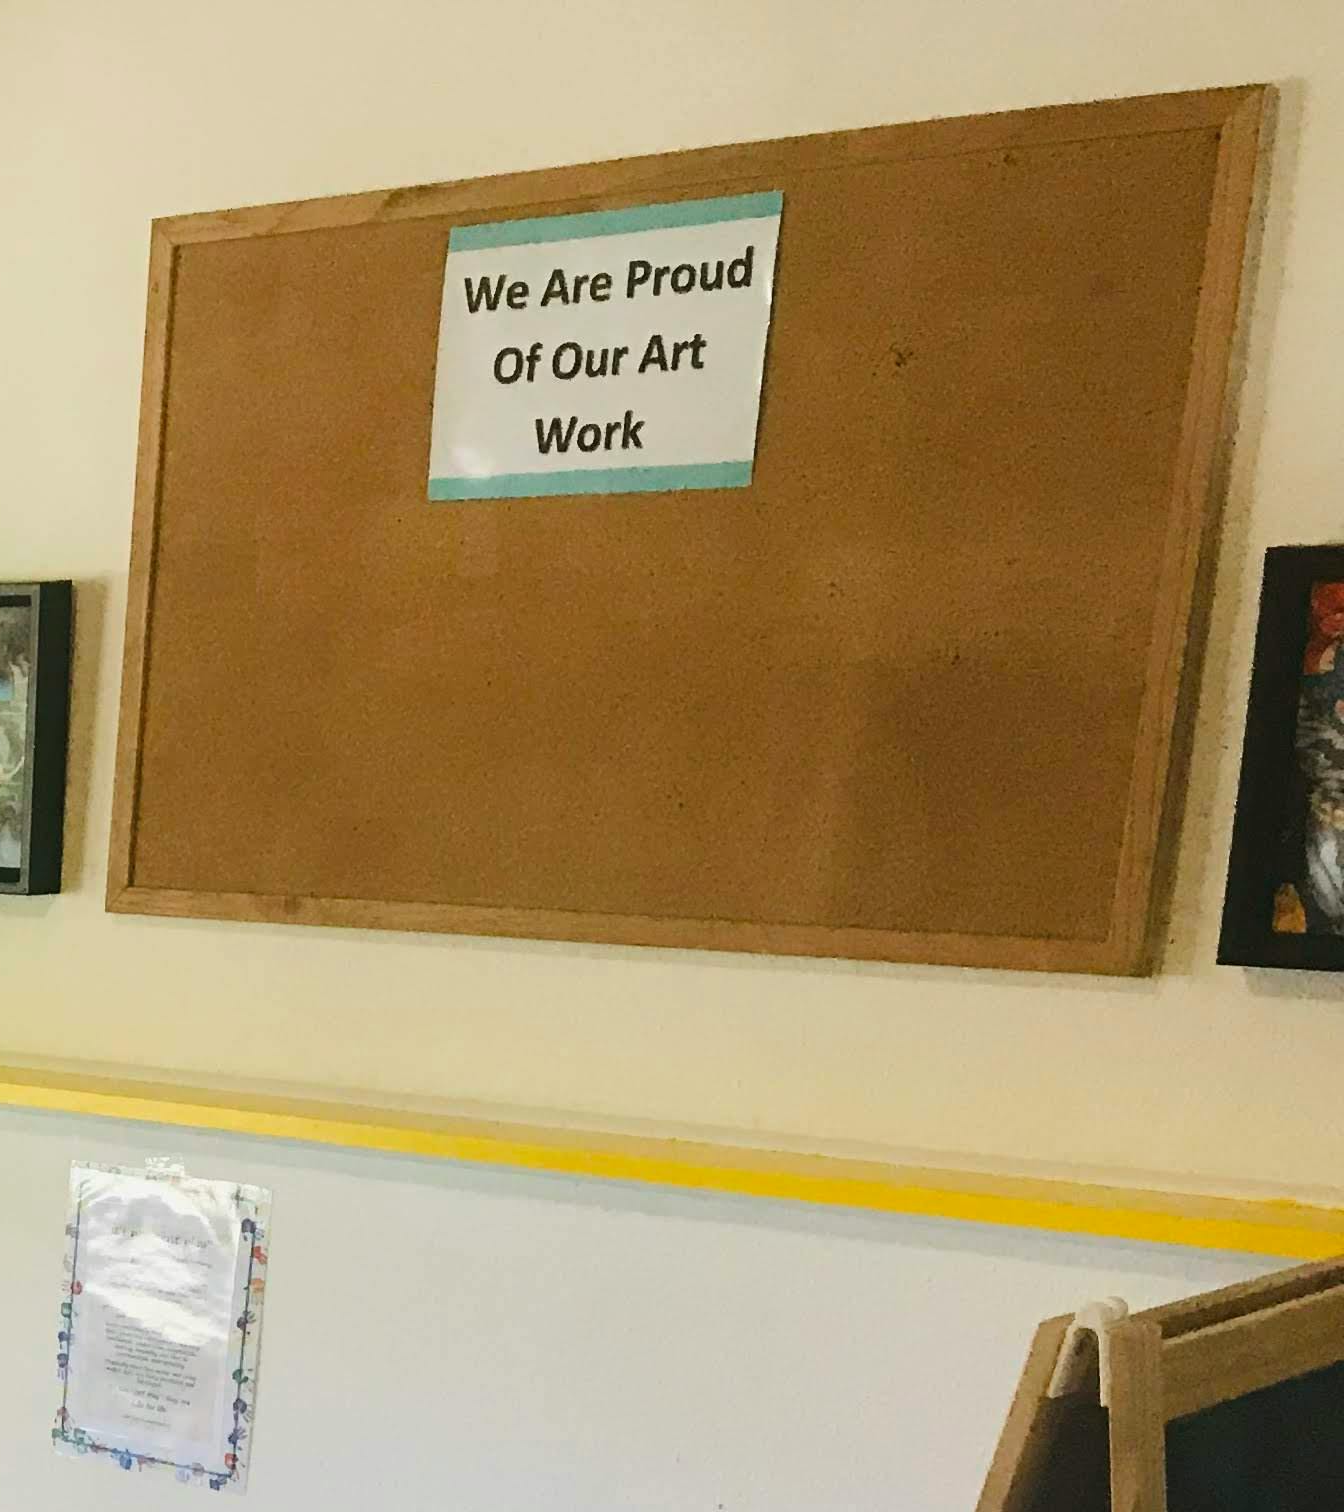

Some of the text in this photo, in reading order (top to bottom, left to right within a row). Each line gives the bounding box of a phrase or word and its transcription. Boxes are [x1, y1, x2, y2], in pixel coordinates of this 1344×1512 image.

[464, 246, 754, 313] We Are Proud
[494, 334, 706, 384] Of Our Art
[536, 410, 644, 454] Work
